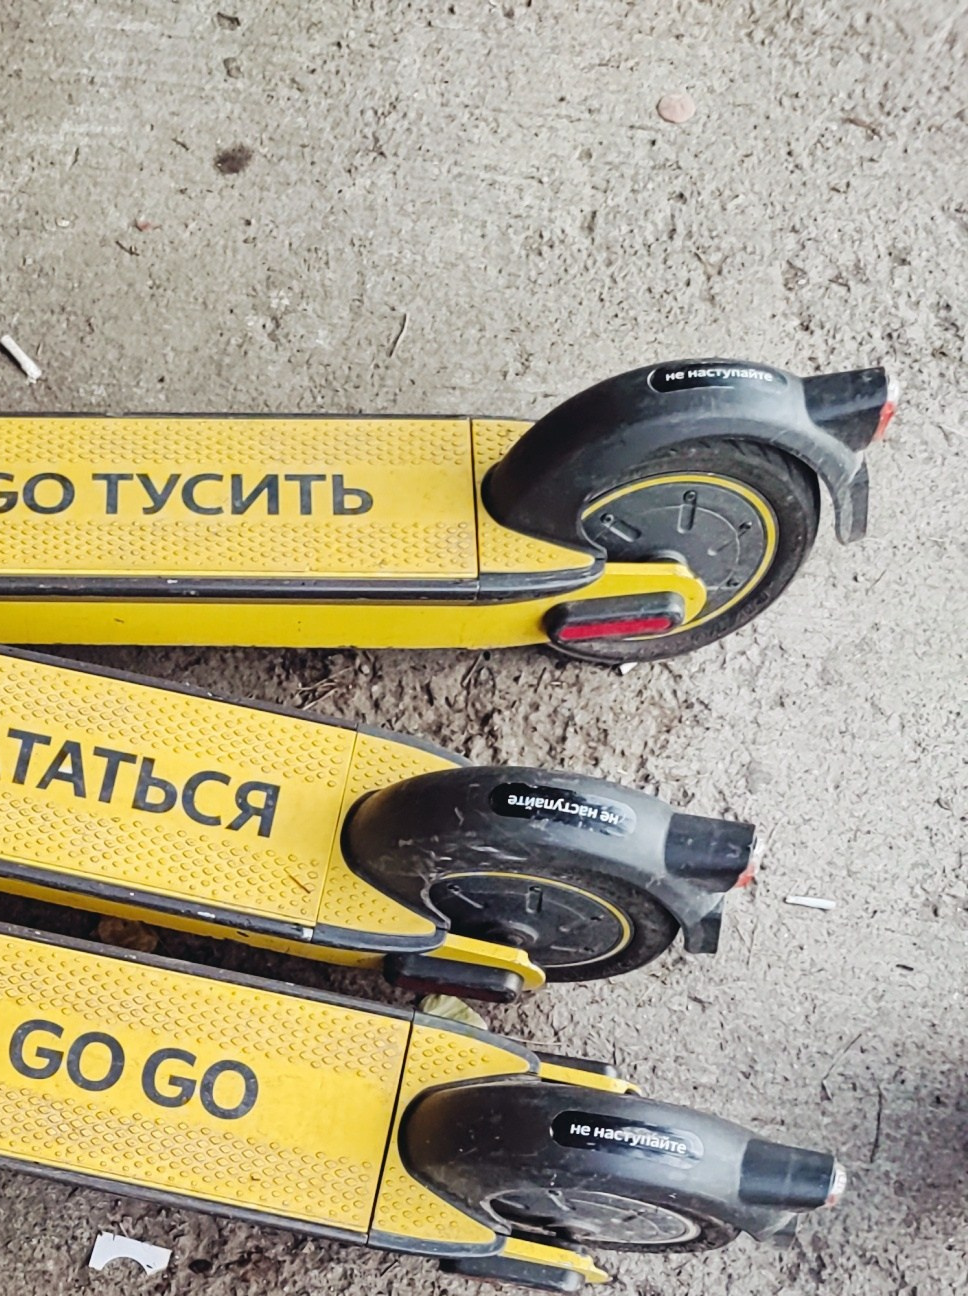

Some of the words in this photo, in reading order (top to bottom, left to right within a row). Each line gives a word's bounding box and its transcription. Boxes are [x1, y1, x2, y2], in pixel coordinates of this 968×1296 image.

[665, 371, 685, 382] не
[688, 368, 773, 382] наступайте
[92, 473, 374, 516] ТУСИТЬ
[507, 794, 599, 819] наступайте
[600, 811, 620, 825] не
[9, 1019, 125, 1092] GO
[141, 1047, 258, 1120] GO
[569, 1123, 591, 1136] не
[593, 1126, 688, 1154] наступайте
